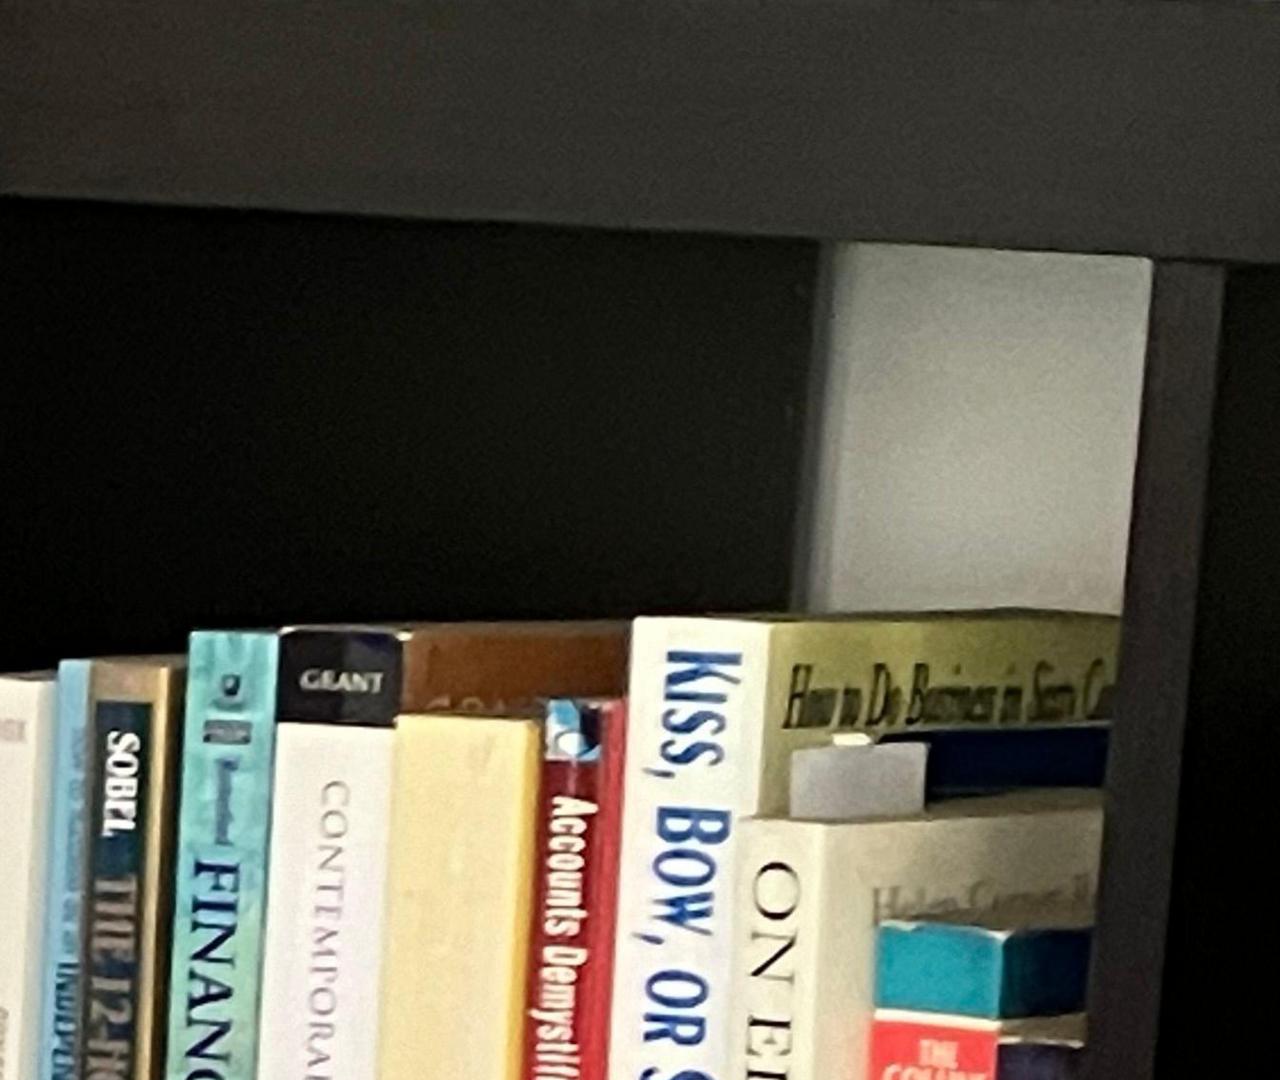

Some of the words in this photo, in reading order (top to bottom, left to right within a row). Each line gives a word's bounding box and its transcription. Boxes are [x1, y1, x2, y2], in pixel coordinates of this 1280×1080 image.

[642, 649, 743, 779] KISS,
[101, 729, 141, 839] SOBEL
[91, 874, 138, 957] THE
[543, 794, 599, 937] Accounts
[631, 805, 733, 945] BOW,
[750, 860, 800, 985] ON
[642, 968, 710, 1047] OR
